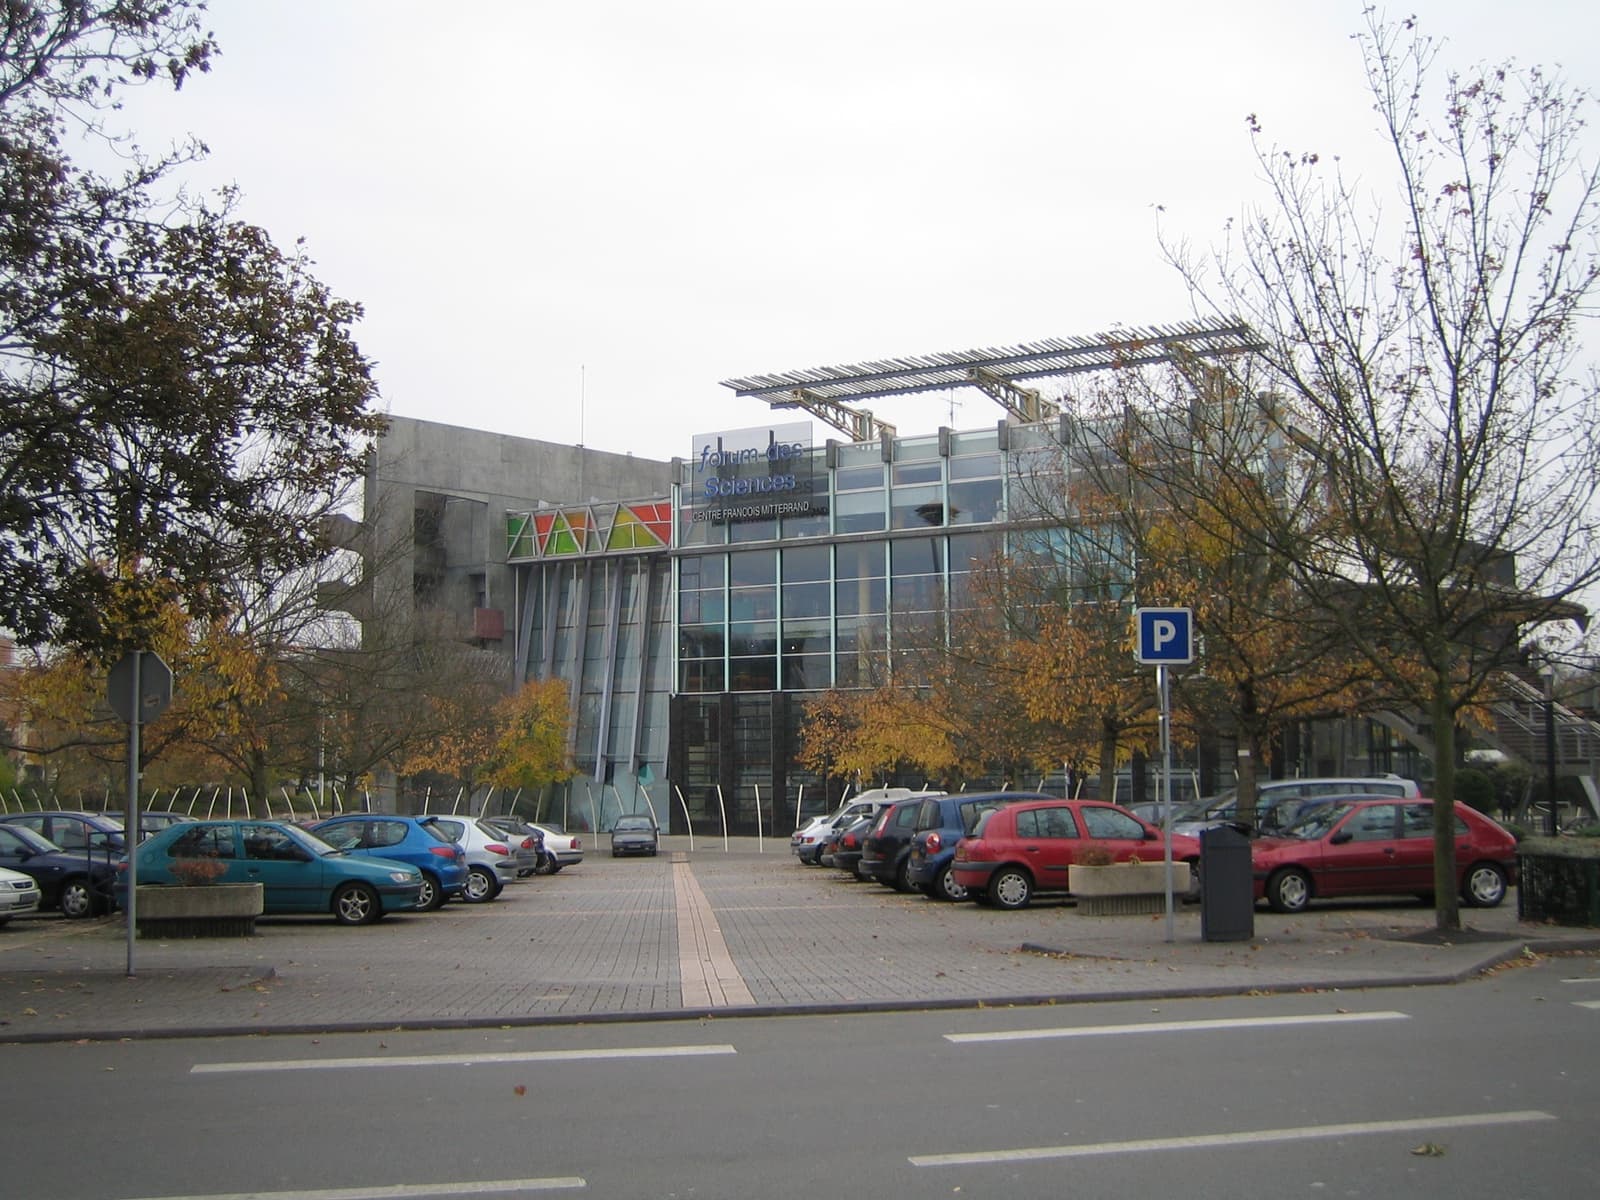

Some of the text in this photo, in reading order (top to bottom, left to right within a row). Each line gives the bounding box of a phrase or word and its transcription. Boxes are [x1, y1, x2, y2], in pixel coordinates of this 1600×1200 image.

[766, 439, 803, 461] des
[704, 474, 796, 499] Sciences
[692, 510, 722, 521] CENTRE
[761, 501, 809, 516] MITTERRAND
[1153, 619, 1176, 652] P
